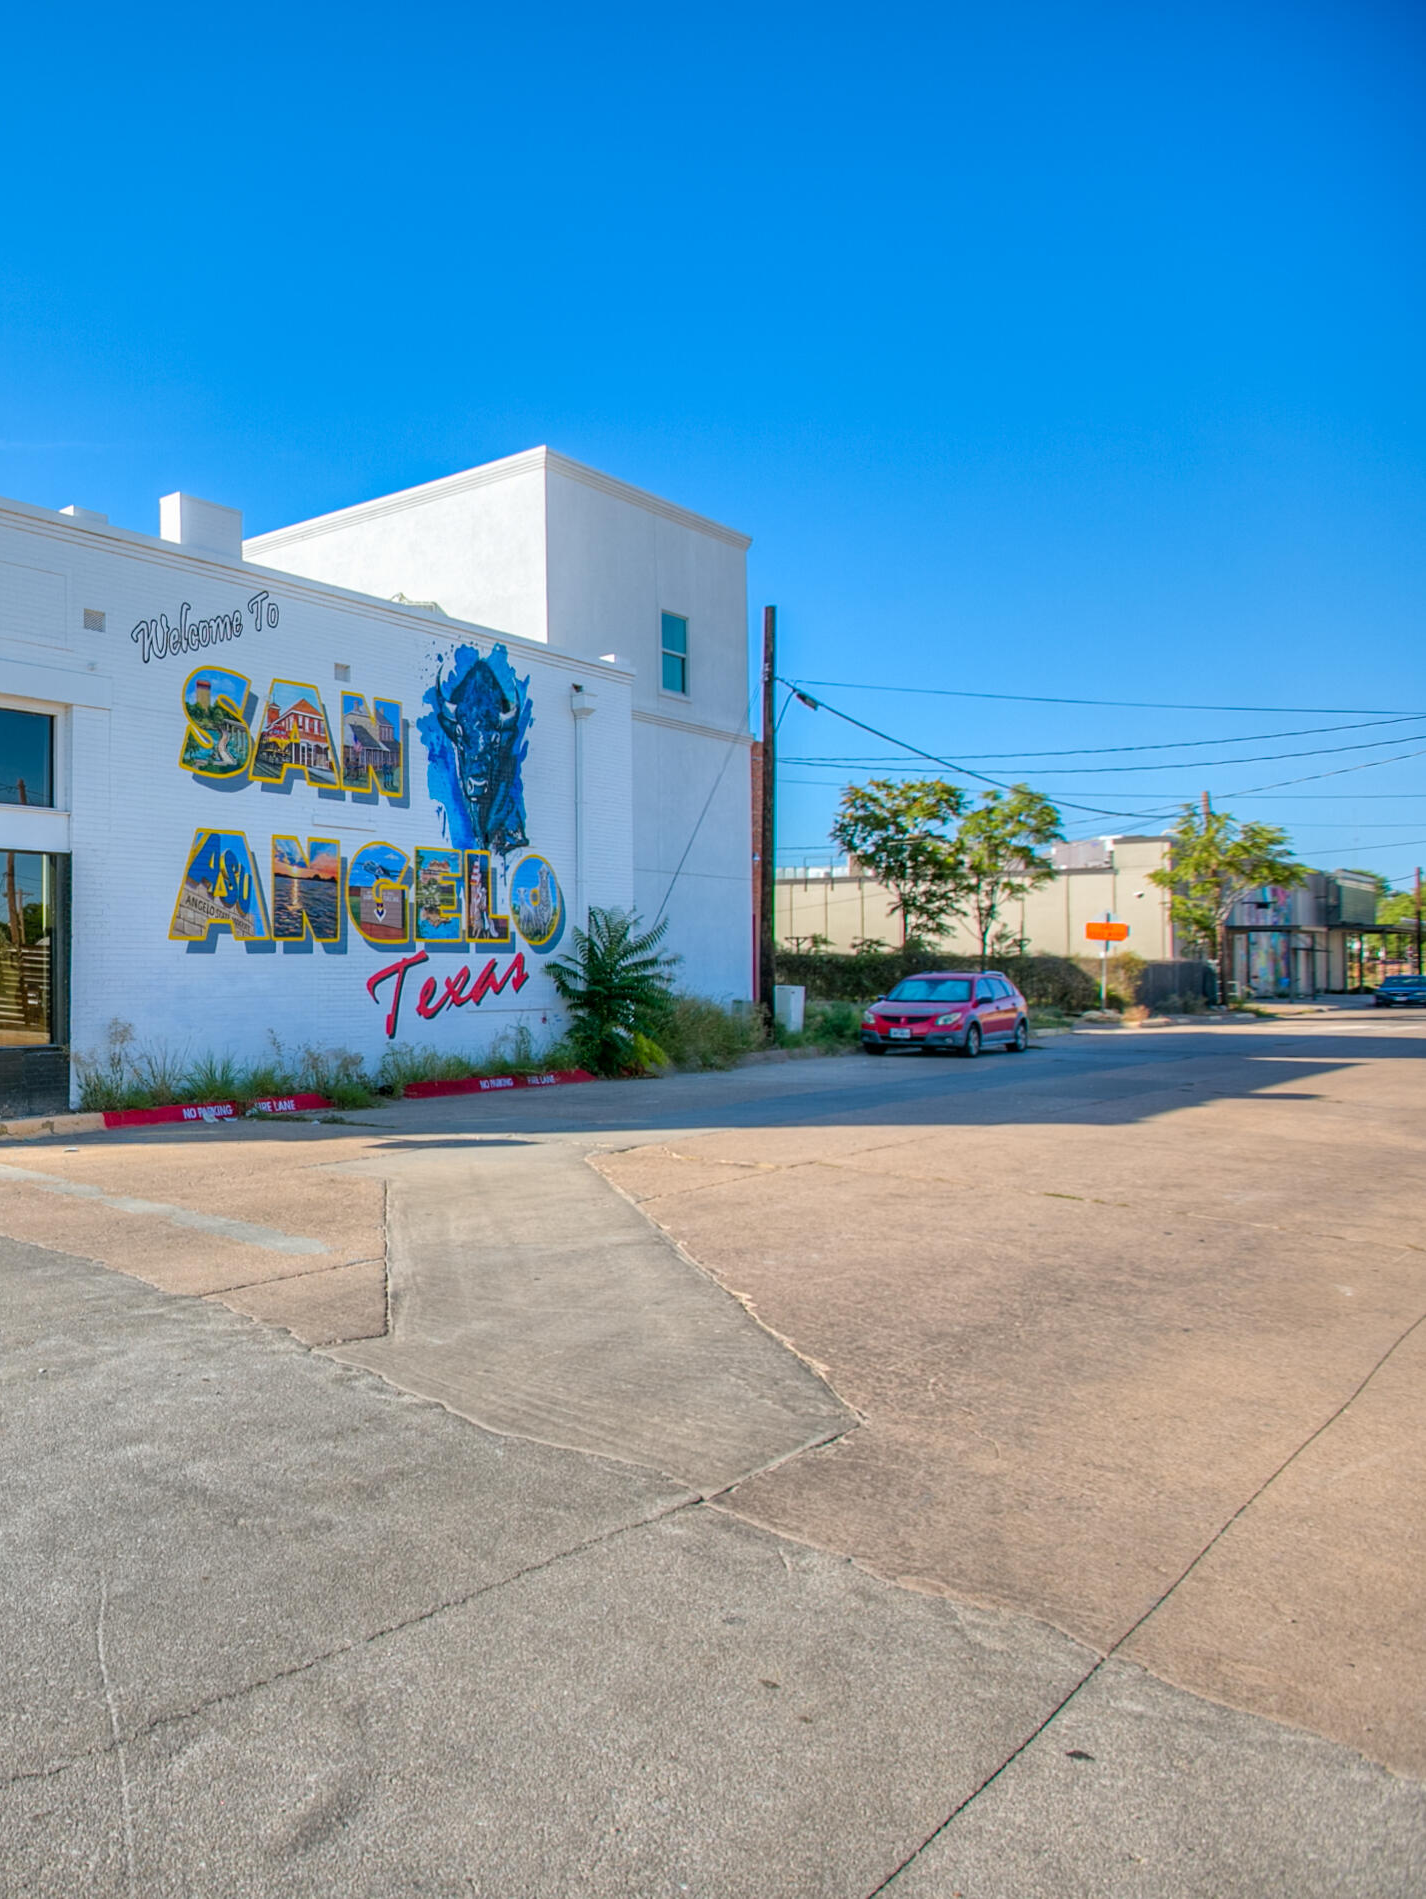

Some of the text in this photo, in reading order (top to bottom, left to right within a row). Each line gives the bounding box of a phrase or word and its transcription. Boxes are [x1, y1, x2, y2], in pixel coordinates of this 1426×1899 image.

[130, 590, 280, 664] Welcome To
[178, 665, 410, 809] SAN
[168, 828, 566, 955] ANGELO
[185, 895, 215, 916] ANGELO
[366, 950, 529, 1039] Texas
[274, 1100, 296, 1112] LANE
[480, 1080, 490, 1089] NO
[183, 1104, 233, 1120] NO PARKING
